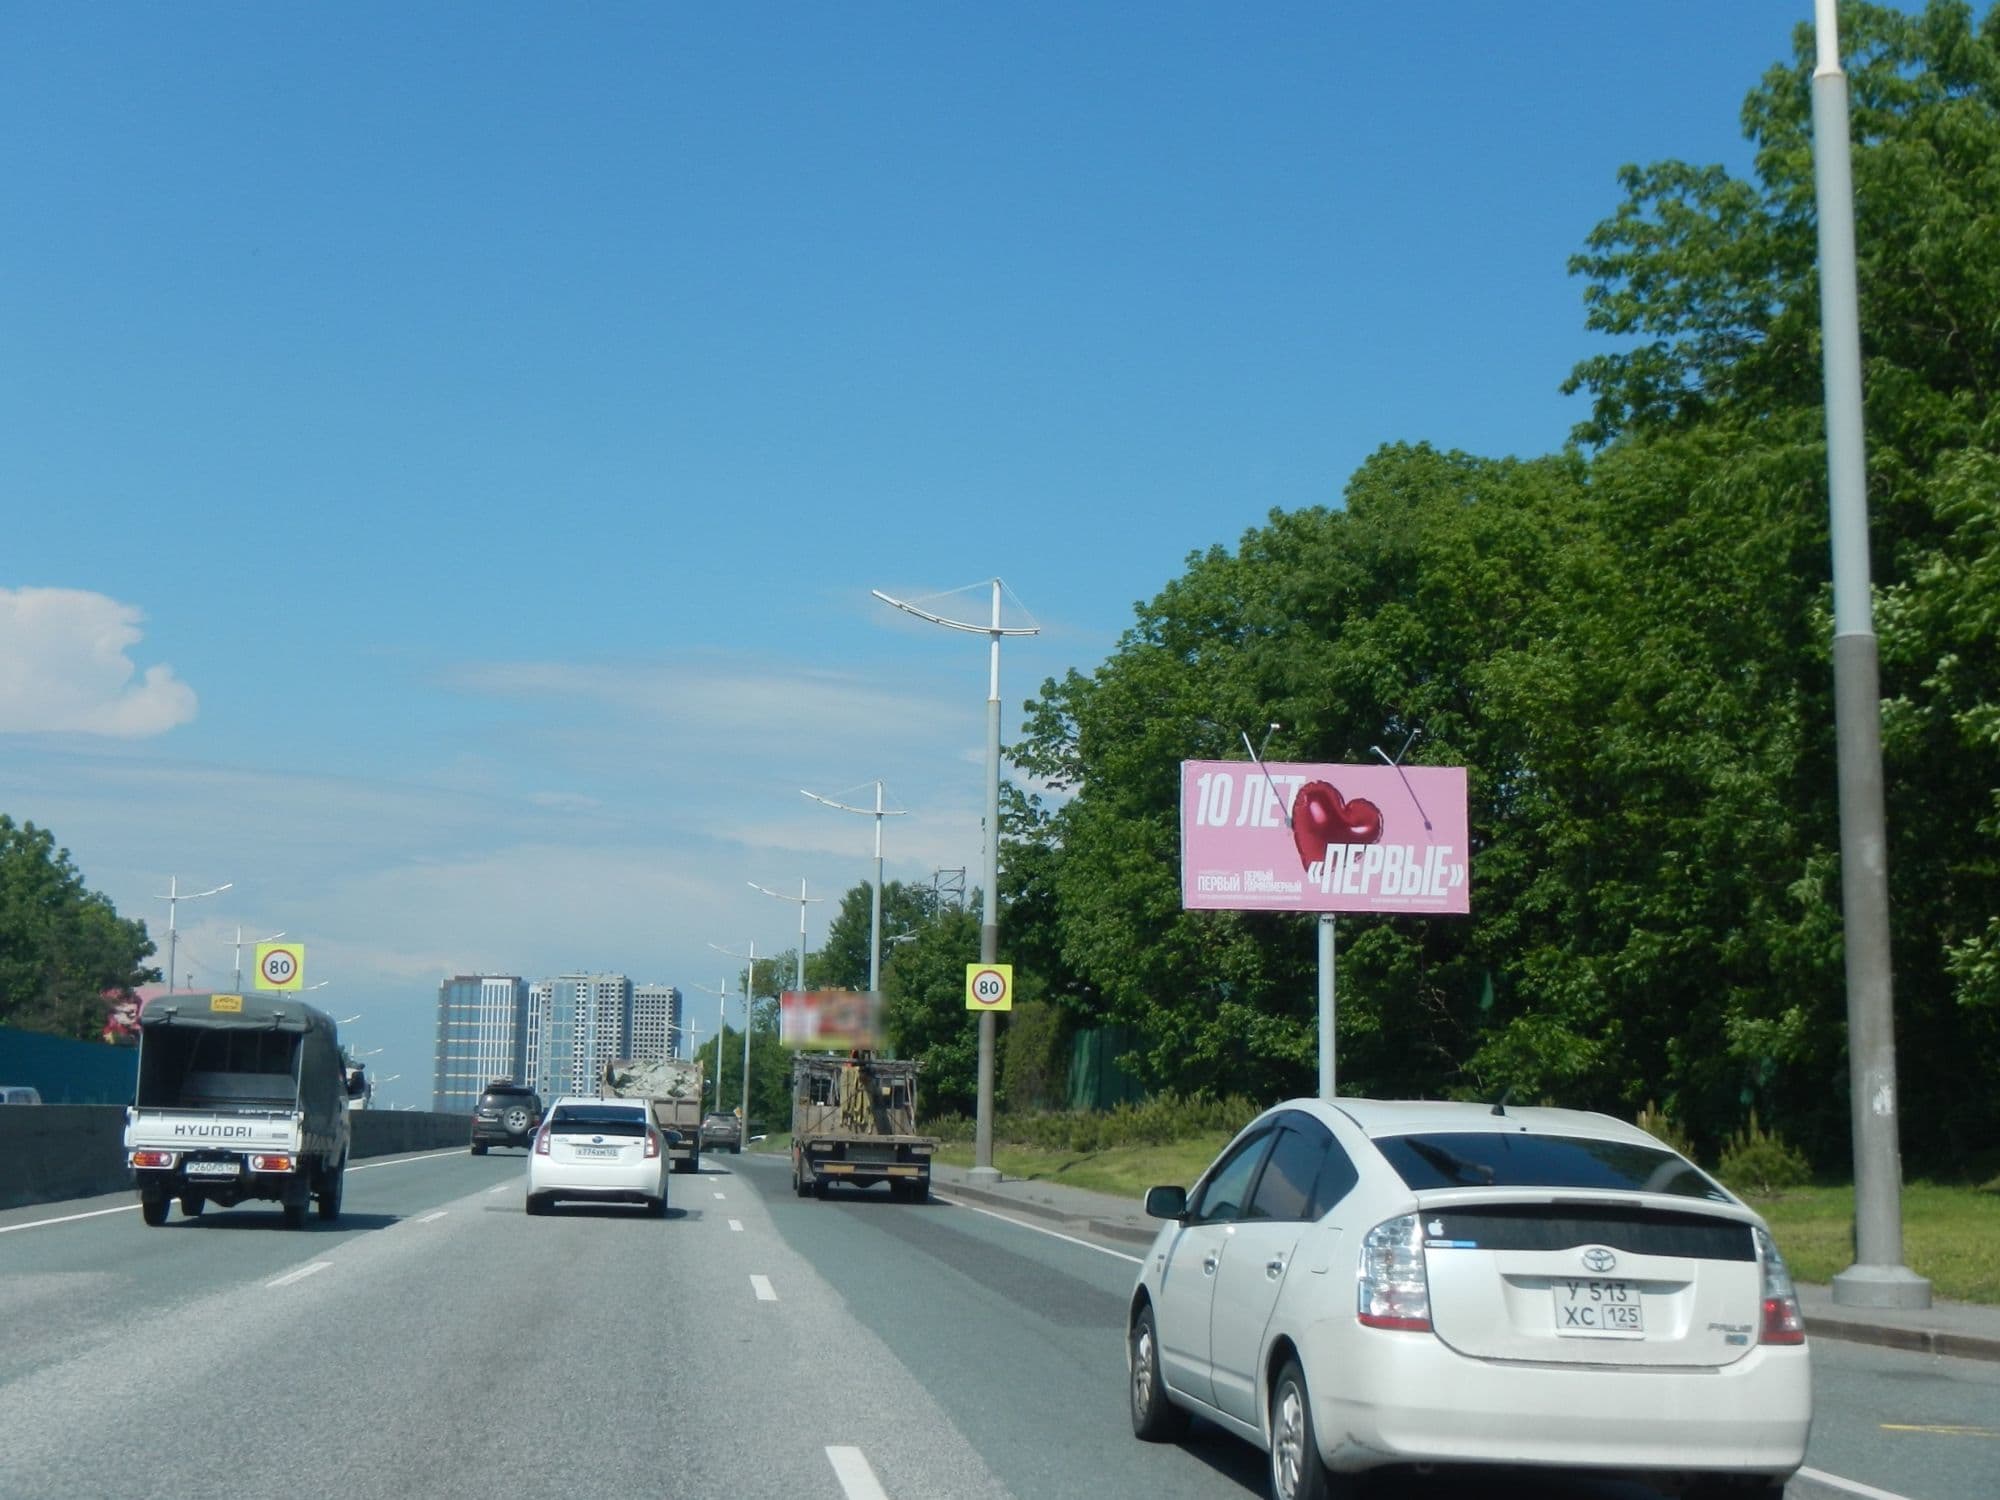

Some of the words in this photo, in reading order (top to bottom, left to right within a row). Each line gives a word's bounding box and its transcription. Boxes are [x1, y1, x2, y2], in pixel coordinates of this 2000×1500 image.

[1197, 773, 1233, 827] 10
[1235, 774, 1306, 828] ЛЕТ
[1307, 843, 1464, 897] «ПЕРВЫЕ»
[1198, 872, 1240, 891] ПЕРВЫЙ
[270, 960, 290, 974] 80
[980, 981, 999, 995] 80
[175, 1125, 252, 1137] HYUNDAI
[1589, 1282, 1627, 1302] 513
[1608, 1307, 1639, 1323] 125
